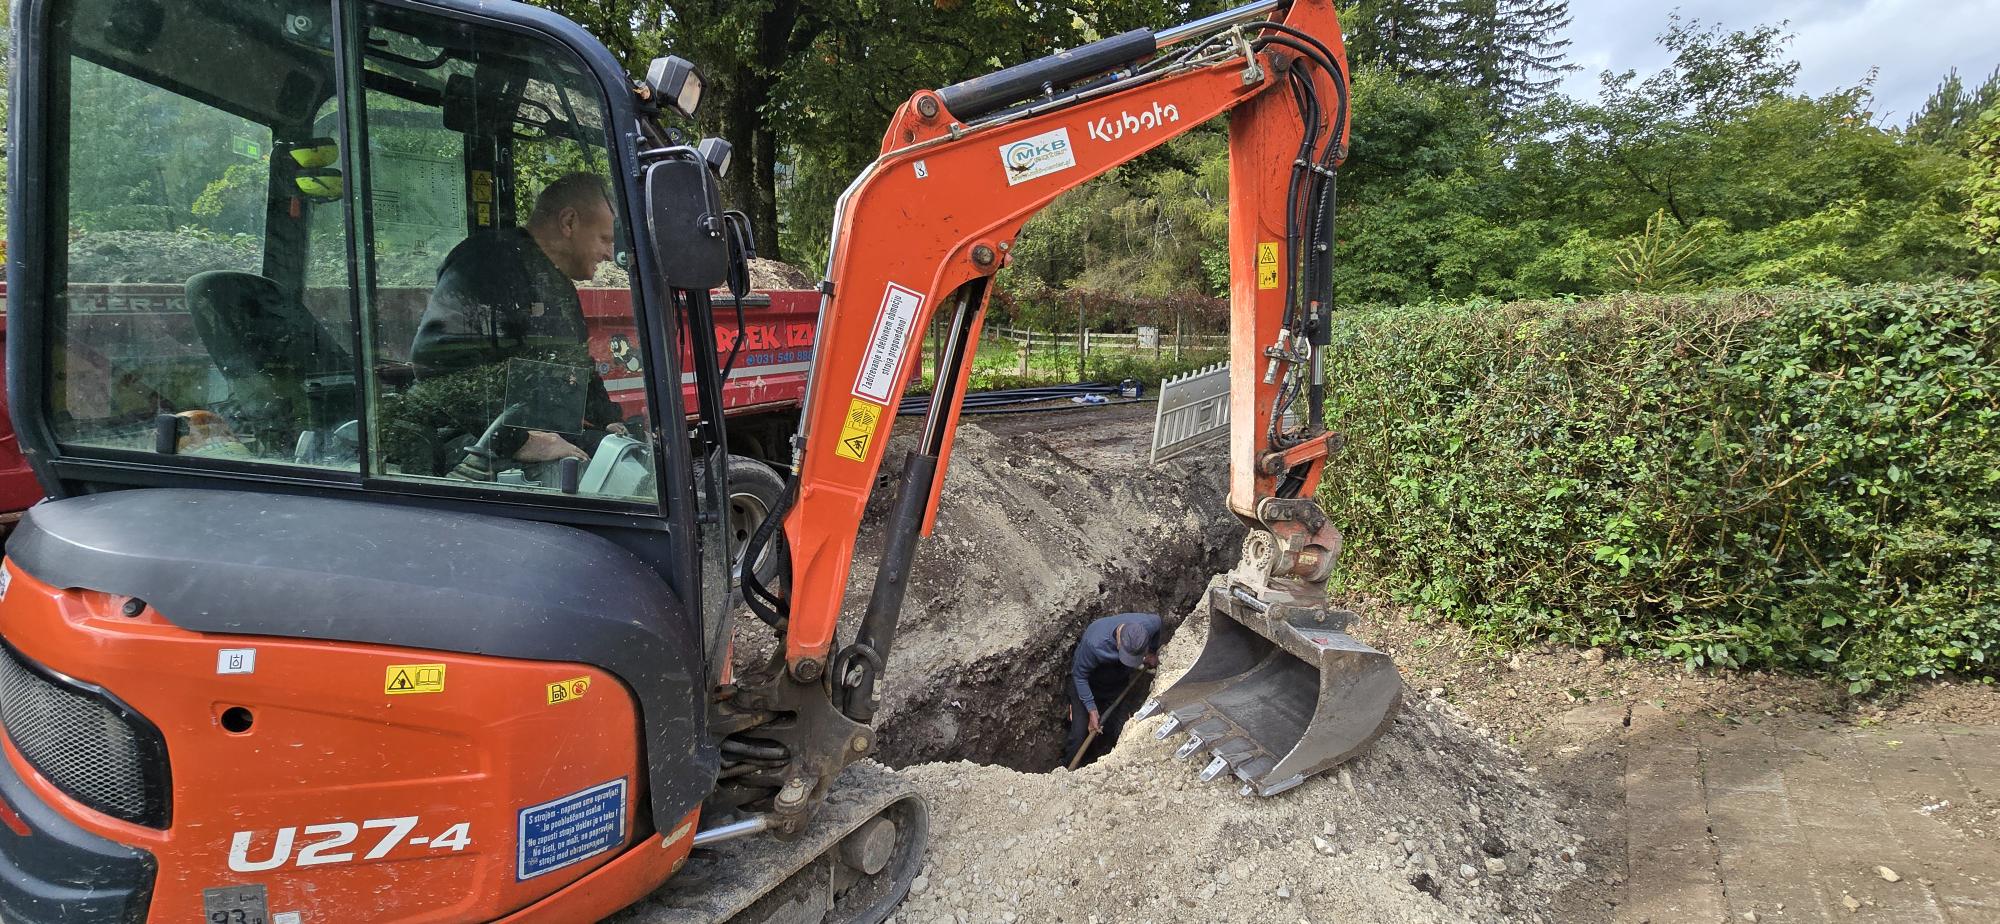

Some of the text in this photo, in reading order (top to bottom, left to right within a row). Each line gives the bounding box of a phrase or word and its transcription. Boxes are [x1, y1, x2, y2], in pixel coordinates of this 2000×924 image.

[1087, 101, 1180, 142] Kubota
[1016, 139, 1066, 161] MKB
[882, 357, 895, 376] stroja
[227, 815, 471, 872] U27-4
